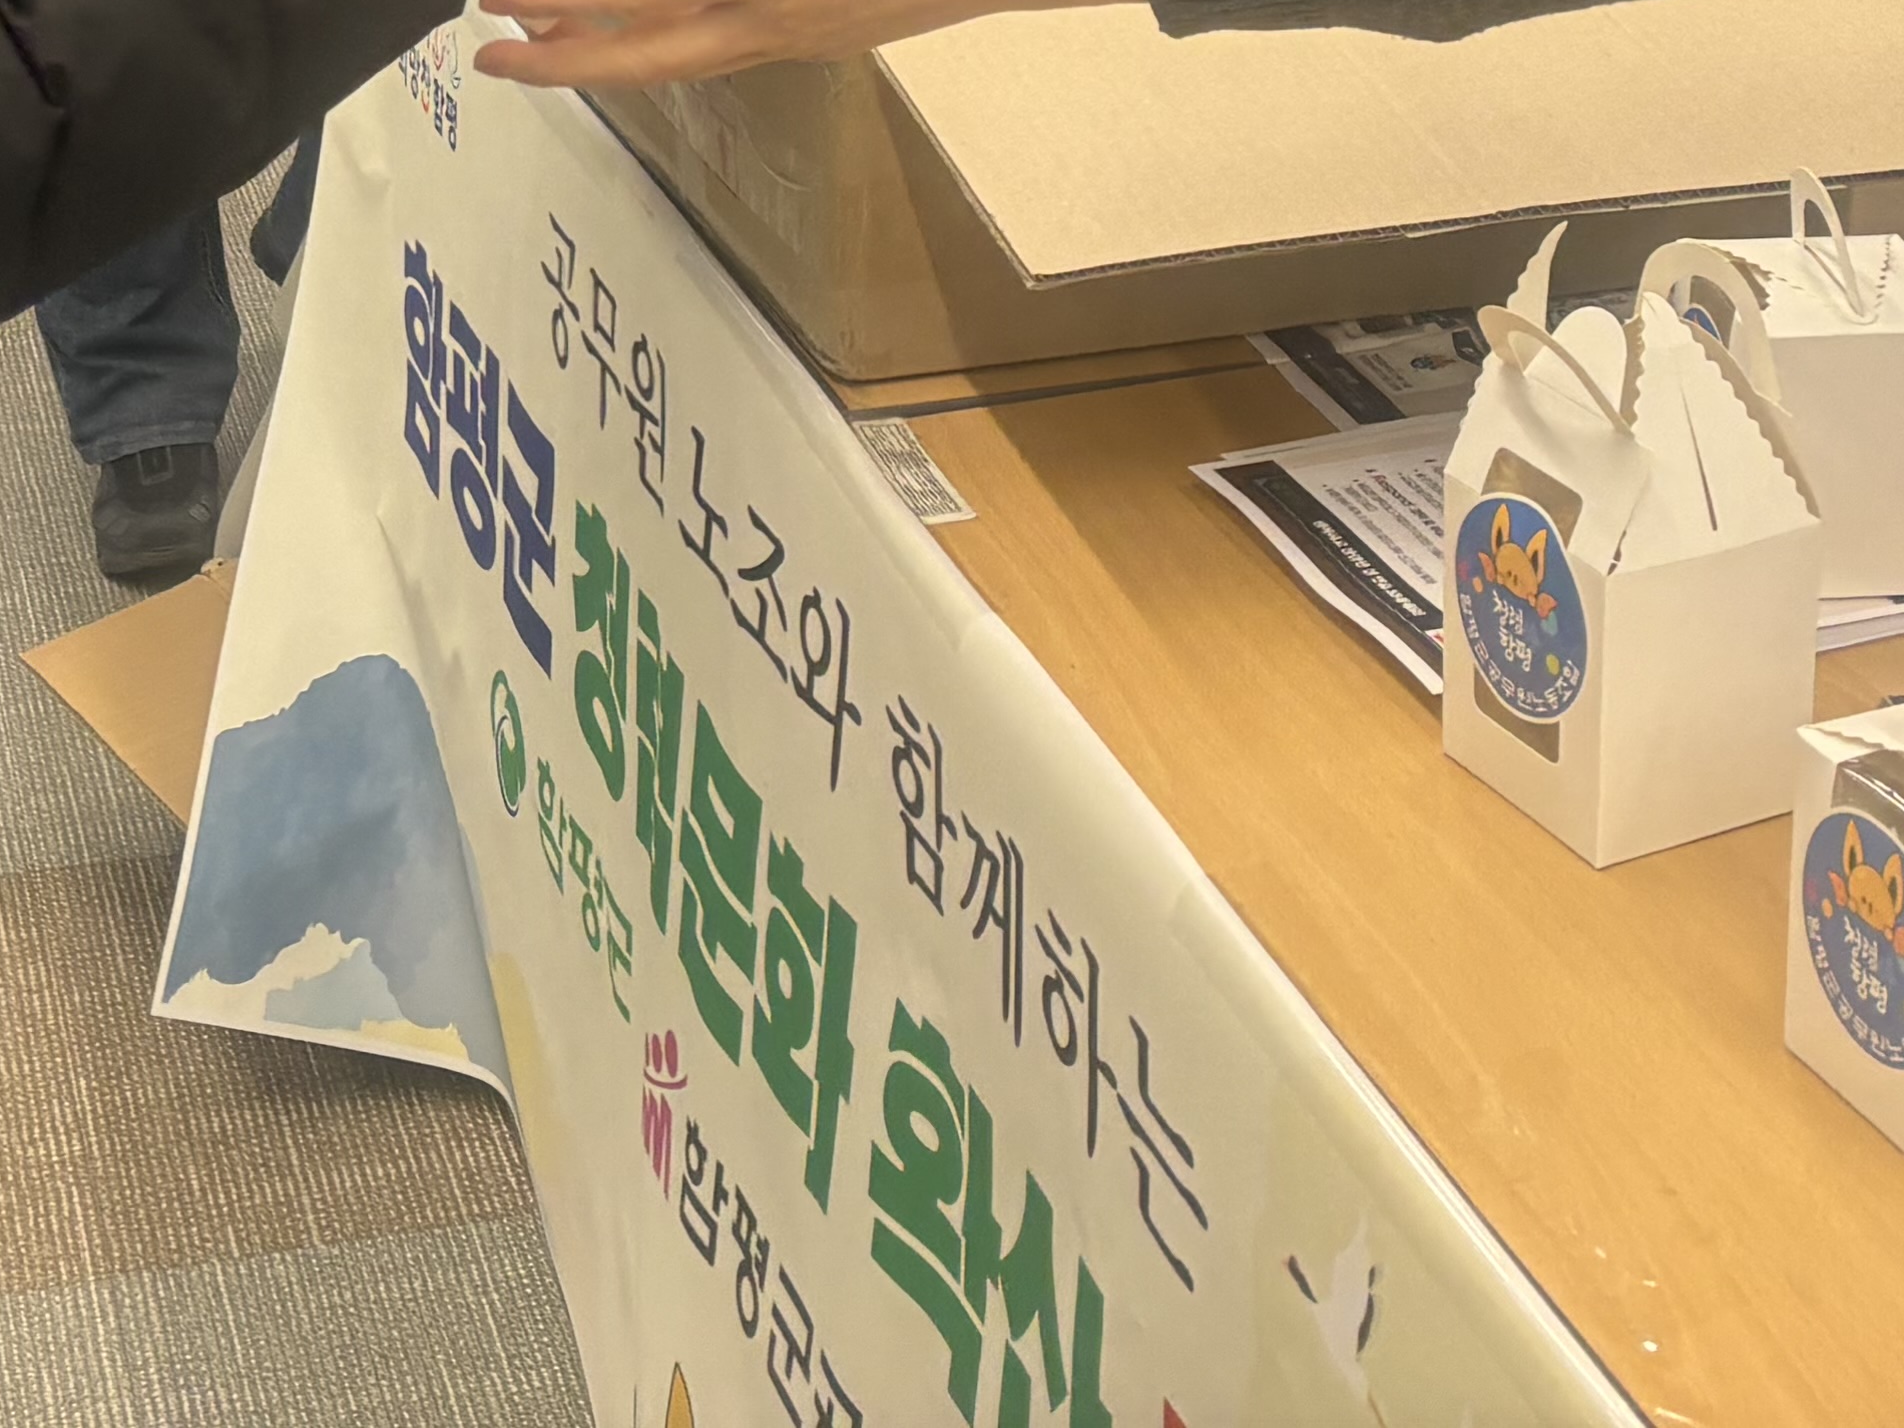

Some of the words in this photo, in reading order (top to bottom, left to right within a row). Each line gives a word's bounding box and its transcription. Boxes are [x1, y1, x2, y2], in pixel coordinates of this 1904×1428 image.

[432, 77, 459, 153] 함평
[401, 239, 556, 678] 함평군
[573, 498, 859, 1211] 청렴문화
[534, 756, 635, 1022] 함평군
[542, 212, 671, 505] 공무원
[678, 425, 859, 789] 노조와
[887, 694, 1210, 1292] 함께하는
